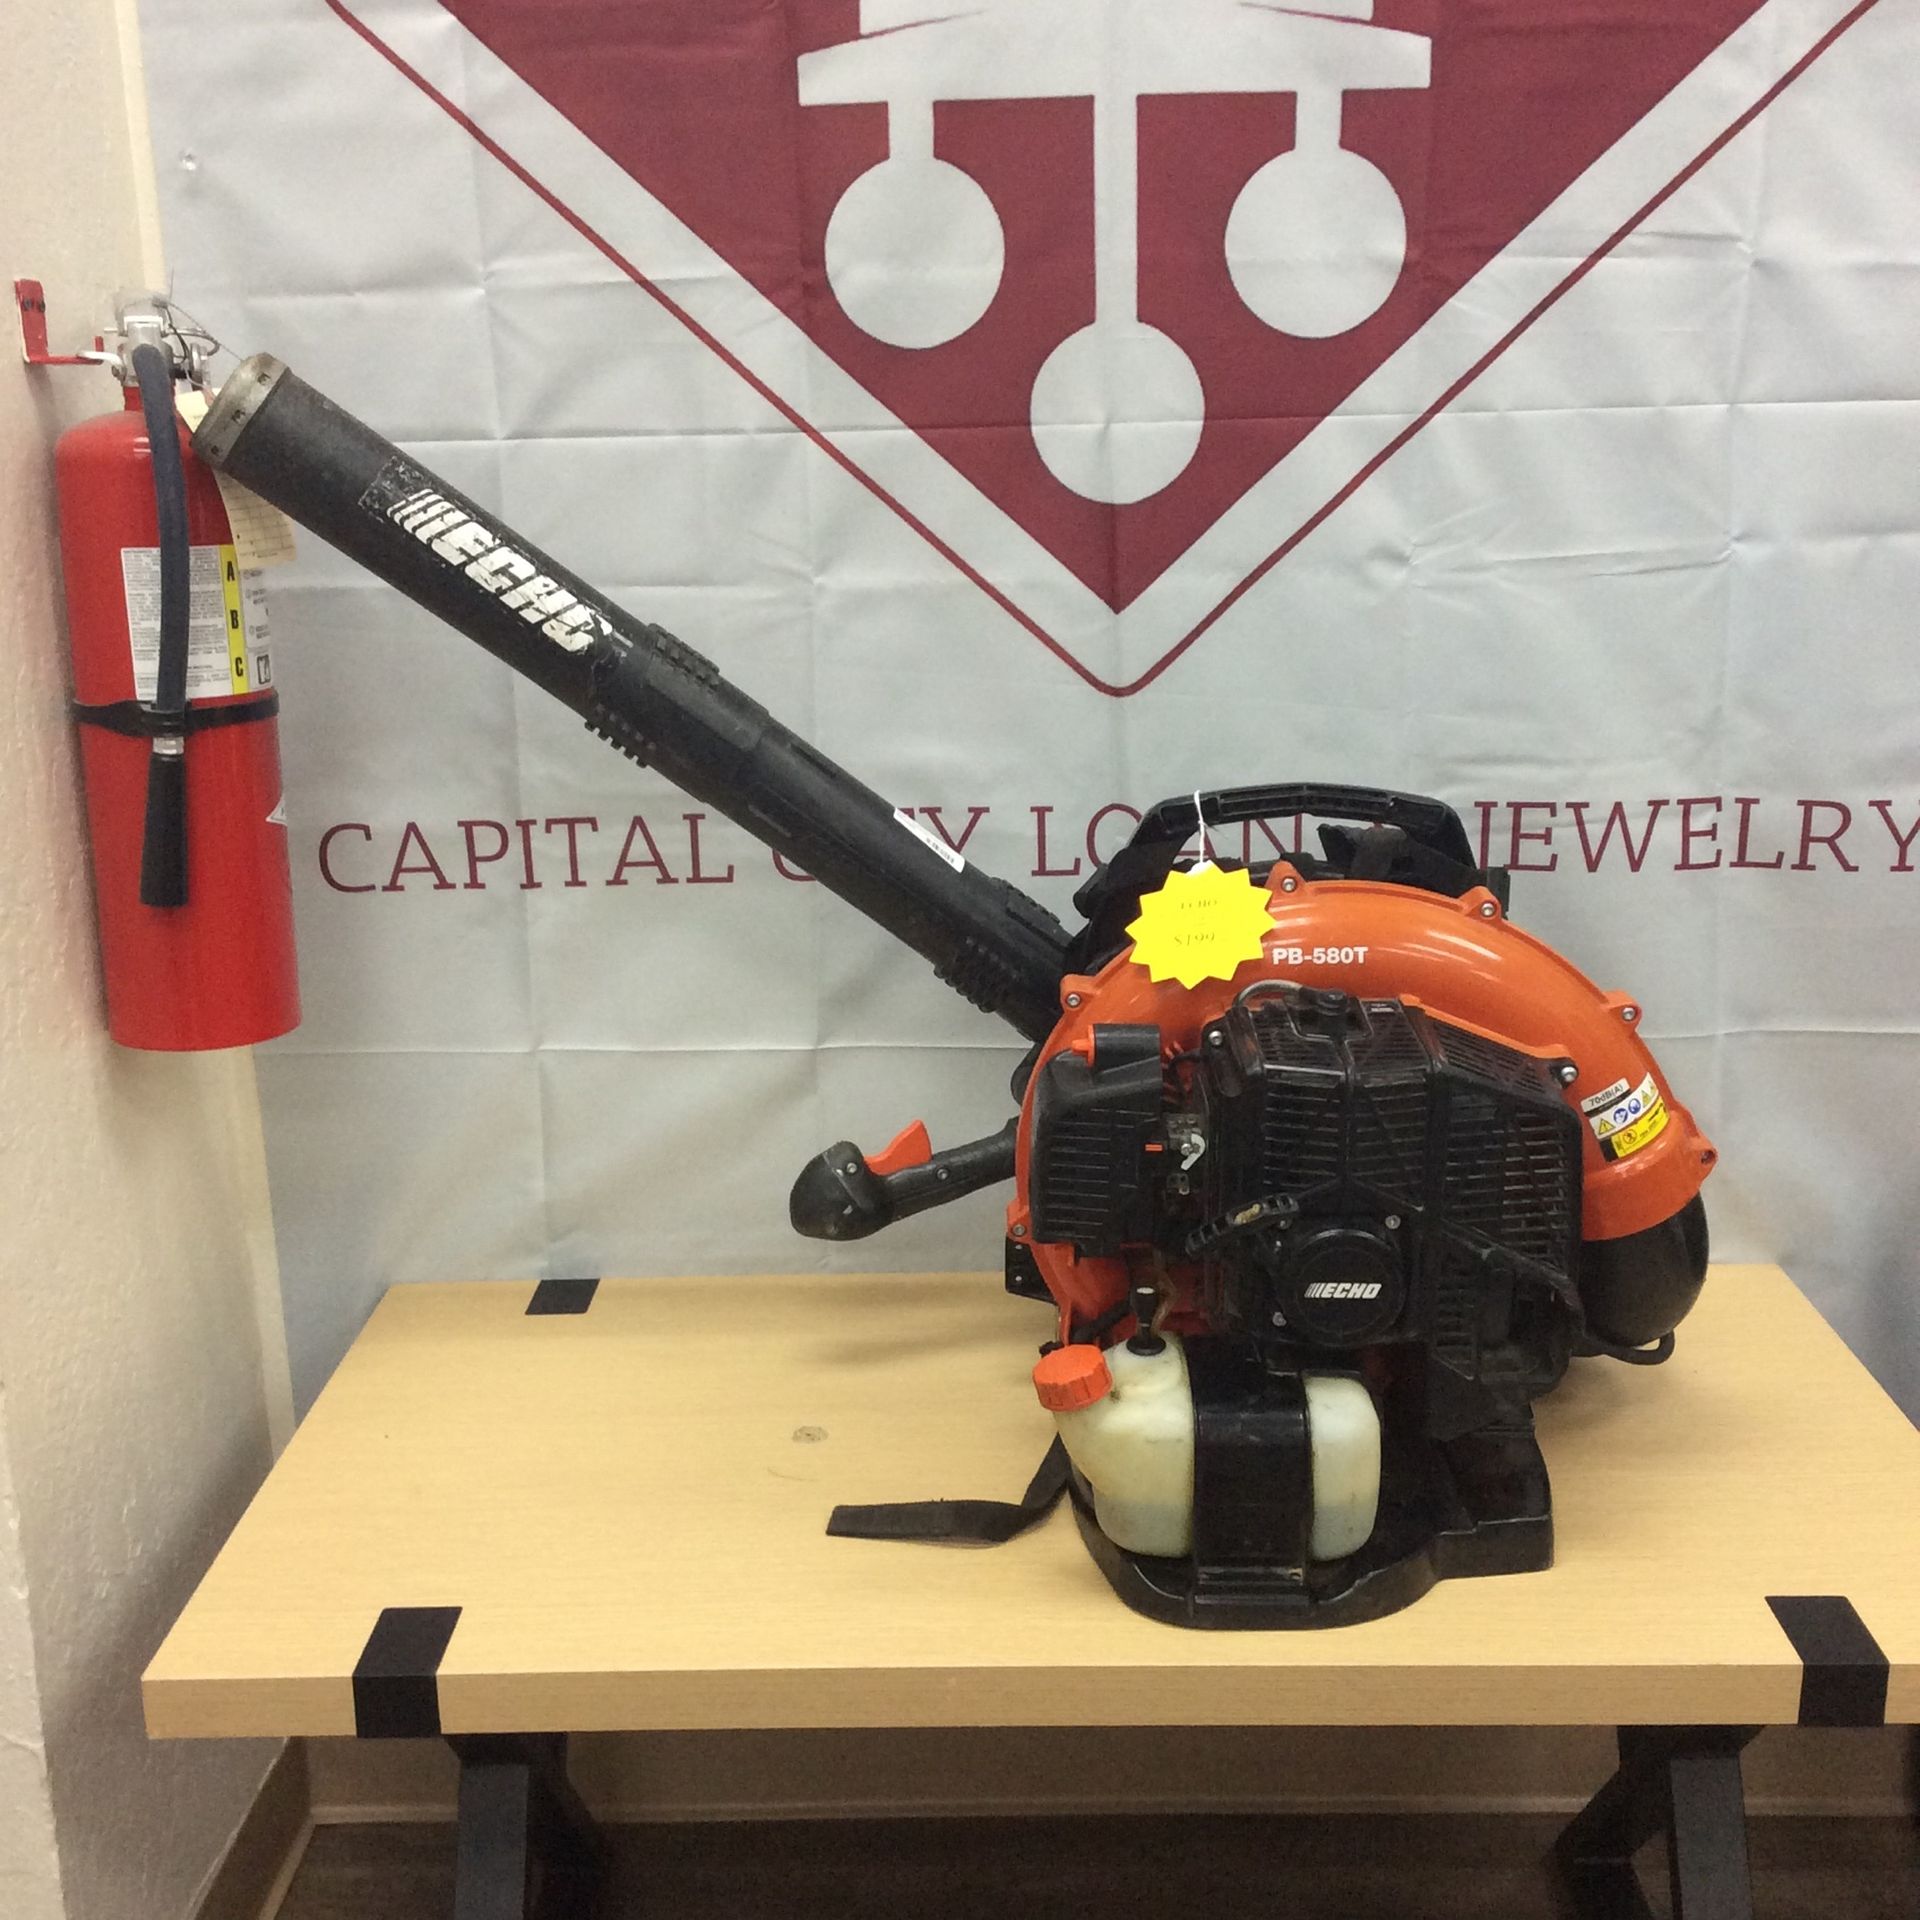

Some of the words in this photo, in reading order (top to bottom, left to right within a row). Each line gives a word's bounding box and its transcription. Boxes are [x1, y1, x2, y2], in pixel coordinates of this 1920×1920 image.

[226, 560, 236, 581] A
[230, 609, 239, 629] B
[235, 656, 244, 677] C
[318, 813, 735, 893] CAPITAL
[1272, 946, 1369, 966] PB-580T
[1588, 1083, 1624, 1107] 70dB(A)
[1320, 1282, 1383, 1300] ECHO
